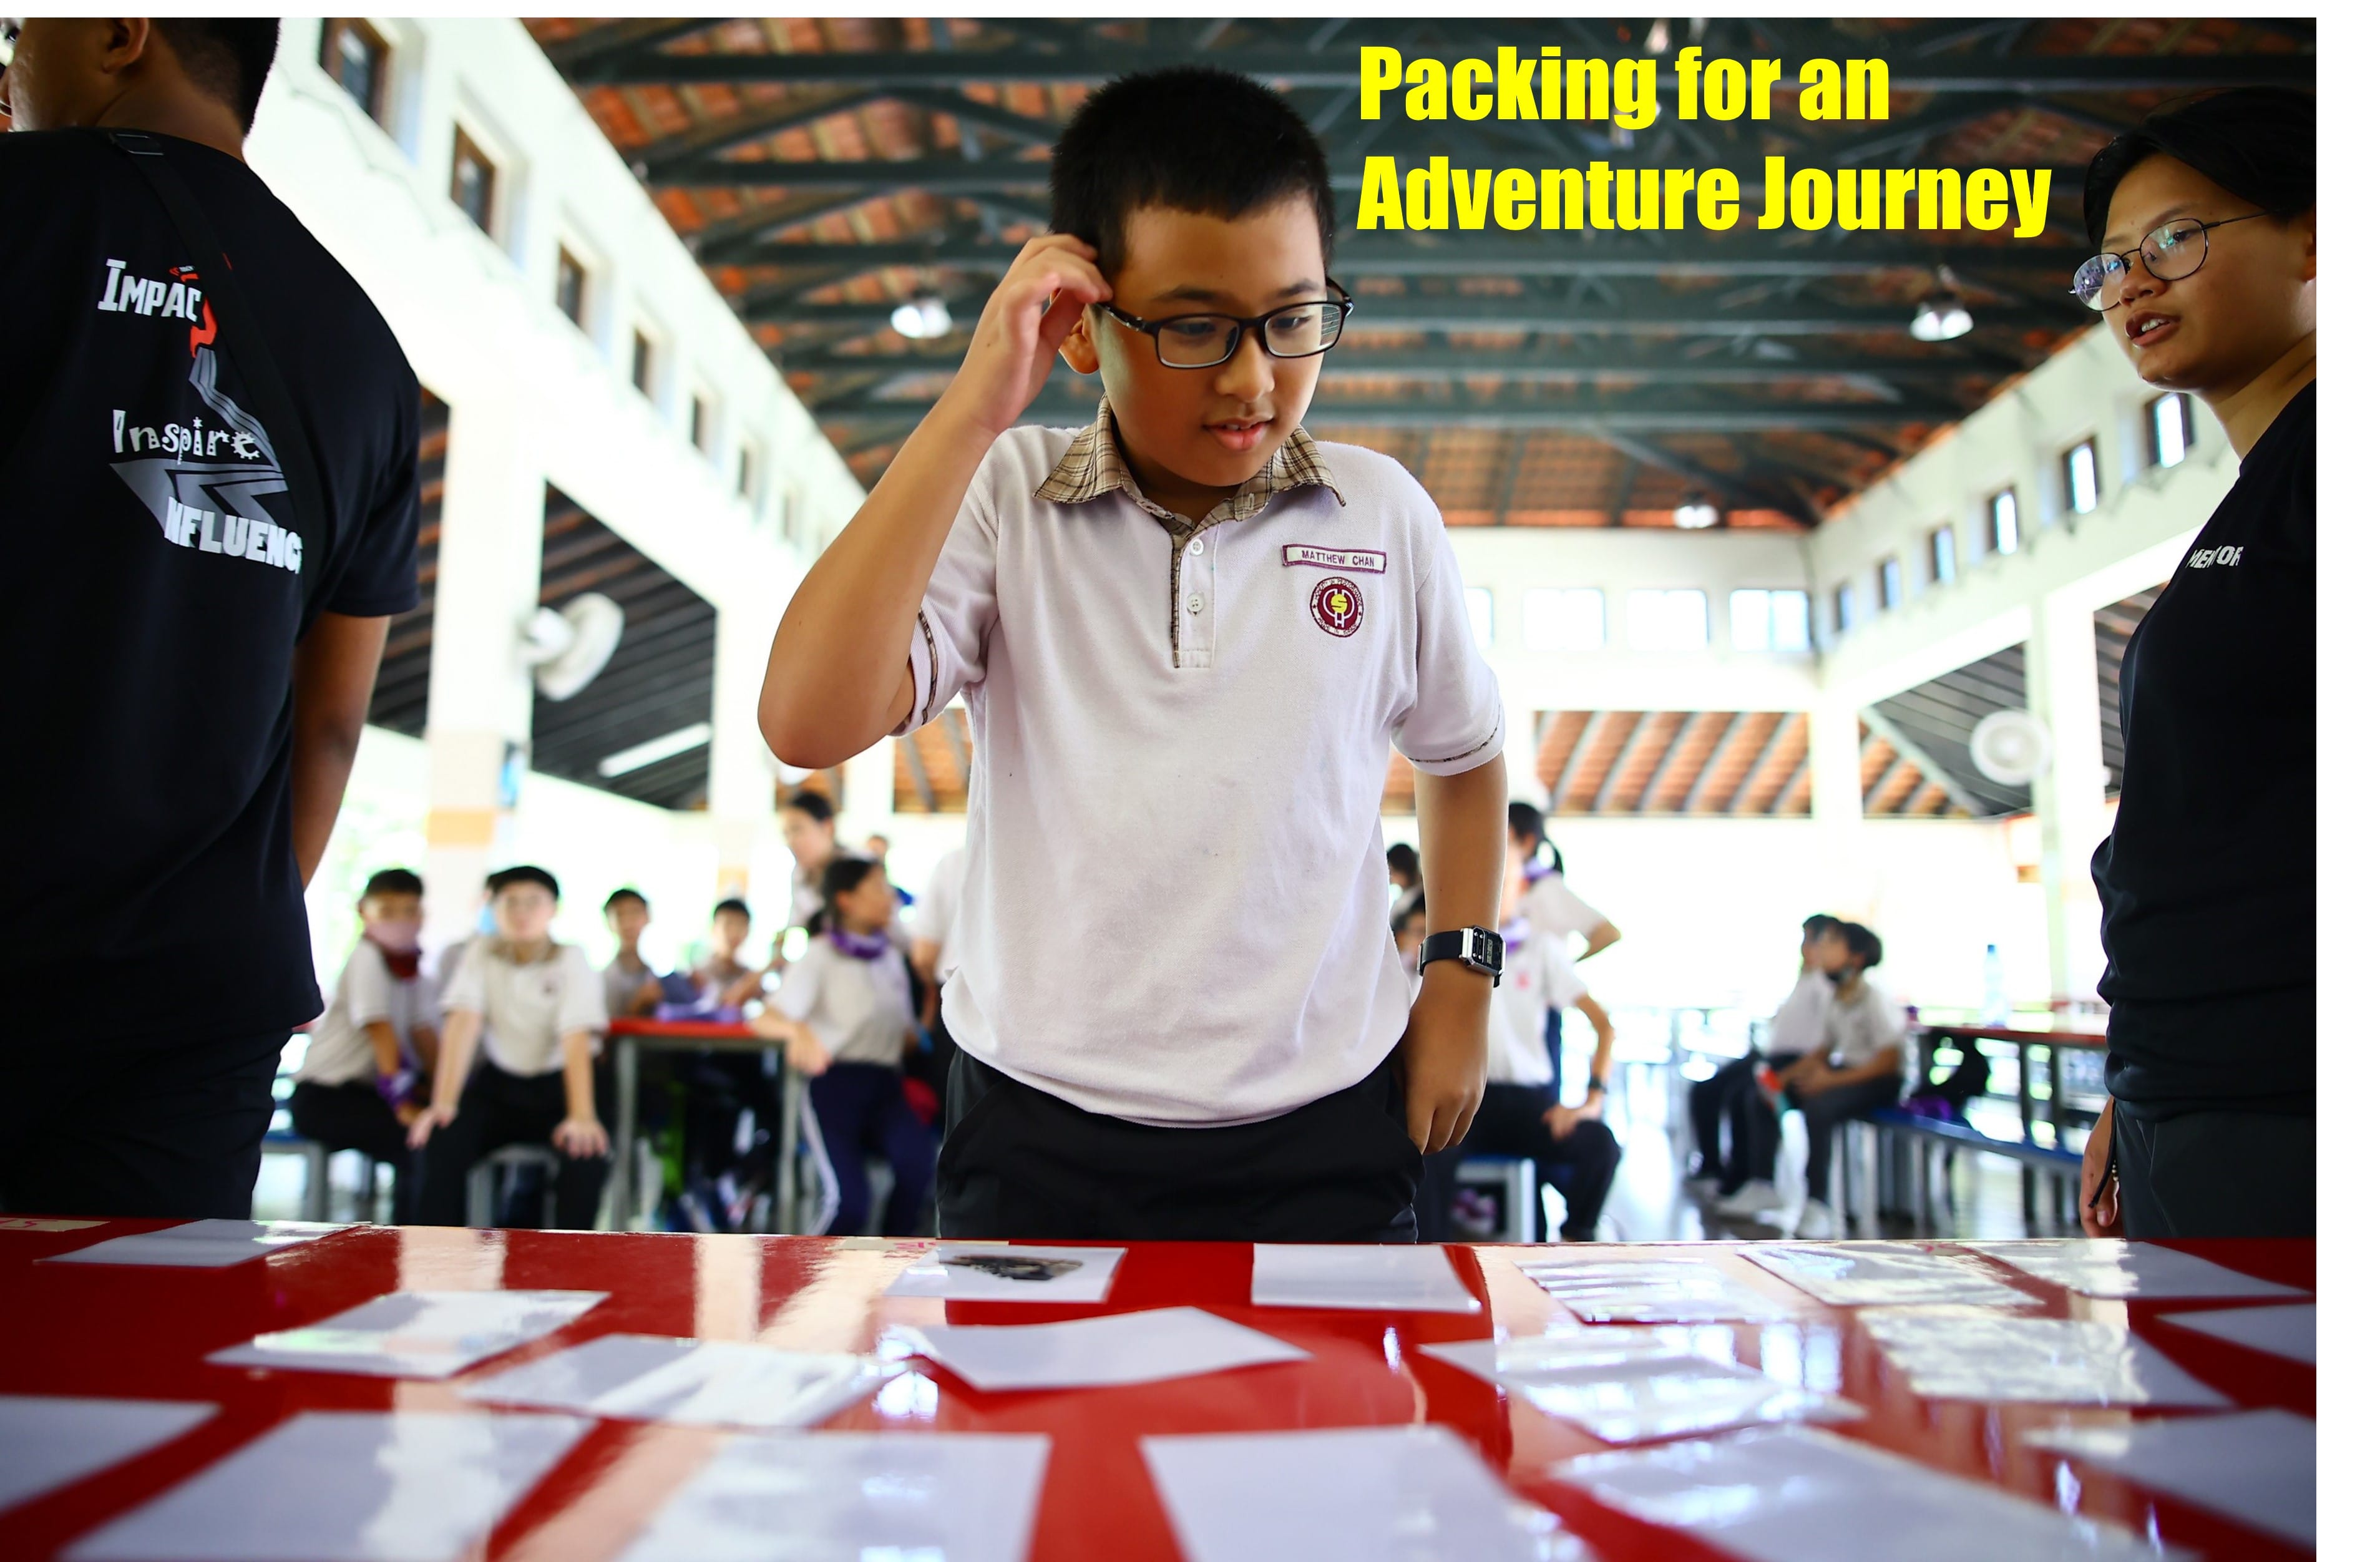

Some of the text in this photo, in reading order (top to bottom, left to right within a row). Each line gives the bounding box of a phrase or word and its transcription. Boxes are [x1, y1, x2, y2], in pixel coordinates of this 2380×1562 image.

[97, 258, 202, 323] IMPAC
[112, 409, 260, 466] Inspire
[163, 495, 303, 575] NFLUENC
[1302, 550, 1375, 567] MATTHEW CHAN
